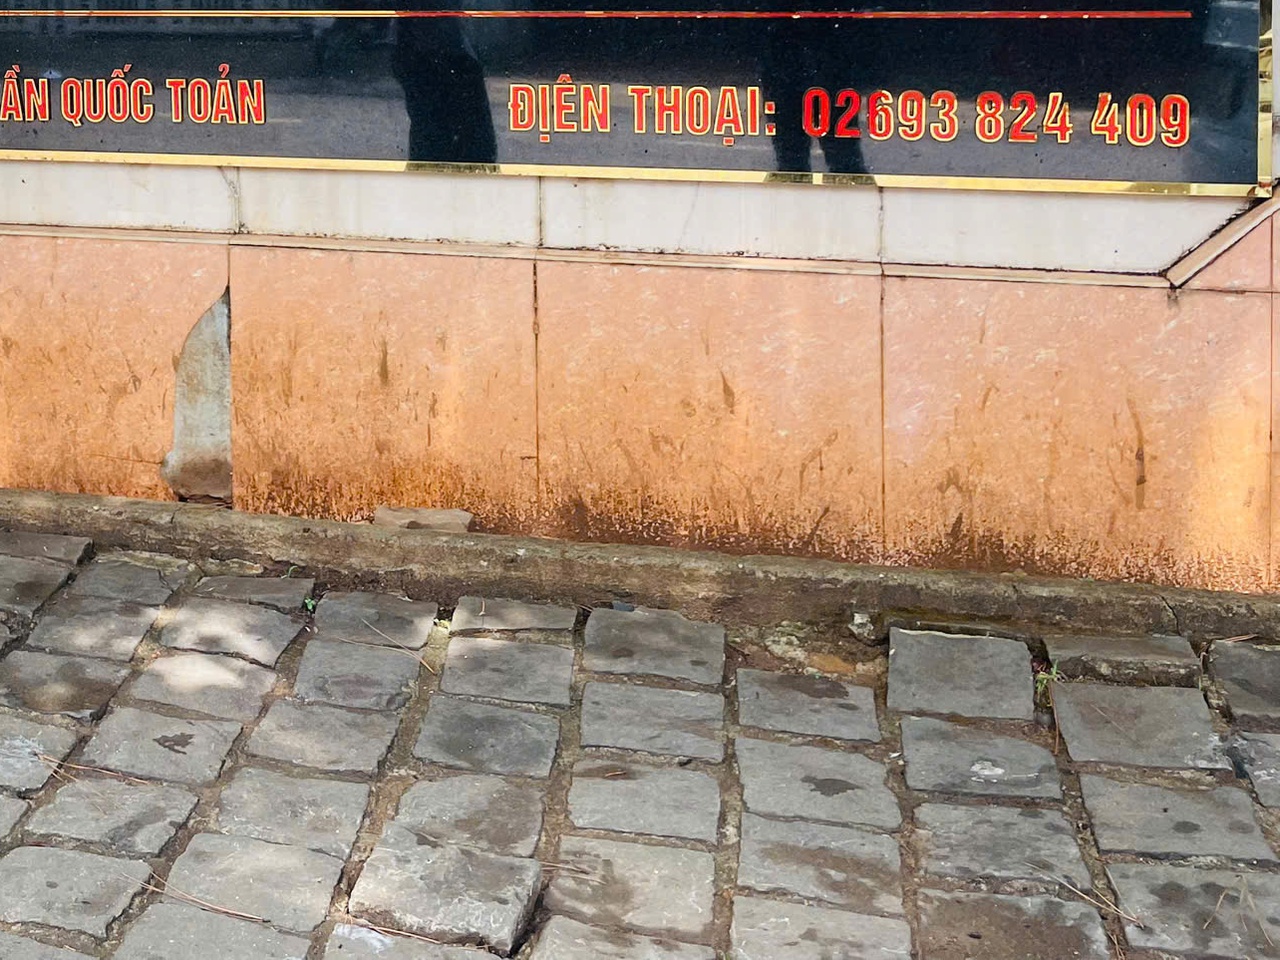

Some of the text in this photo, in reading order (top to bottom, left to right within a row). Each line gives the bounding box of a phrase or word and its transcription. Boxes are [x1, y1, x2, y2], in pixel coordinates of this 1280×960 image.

[61, 63, 154, 127] QUỐC
[166, 63, 265, 124] TOẢN
[627, 85, 776, 146] THOẠI:
[802, 88, 959, 142] 02693
[975, 90, 1074, 144] 824
[1091, 92, 1191, 148] 409
